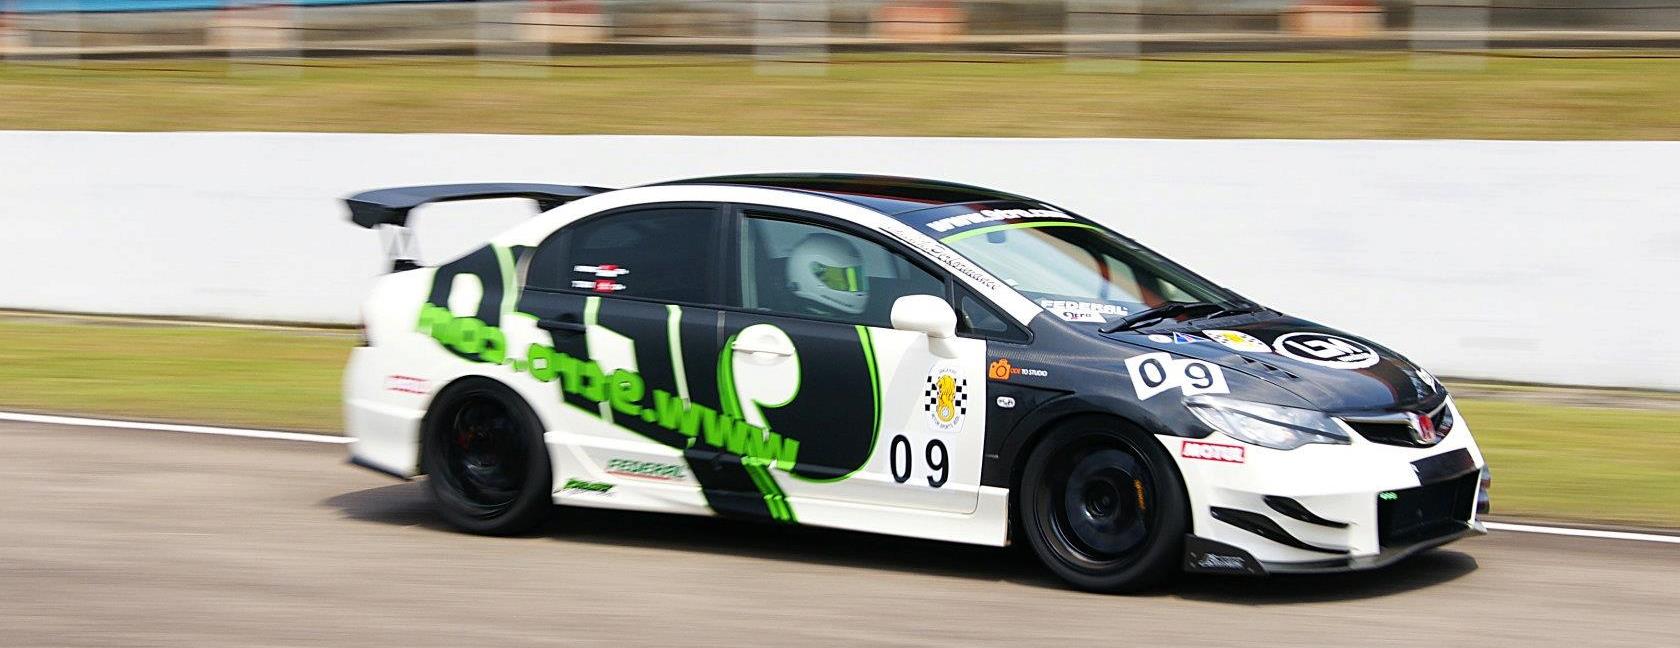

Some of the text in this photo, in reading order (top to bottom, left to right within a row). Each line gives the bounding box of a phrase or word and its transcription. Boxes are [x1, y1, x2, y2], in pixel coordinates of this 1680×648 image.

[1040, 299, 1129, 316] FEDERAL
[1139, 357, 1214, 390] 09
[889, 434, 950, 489] 09
